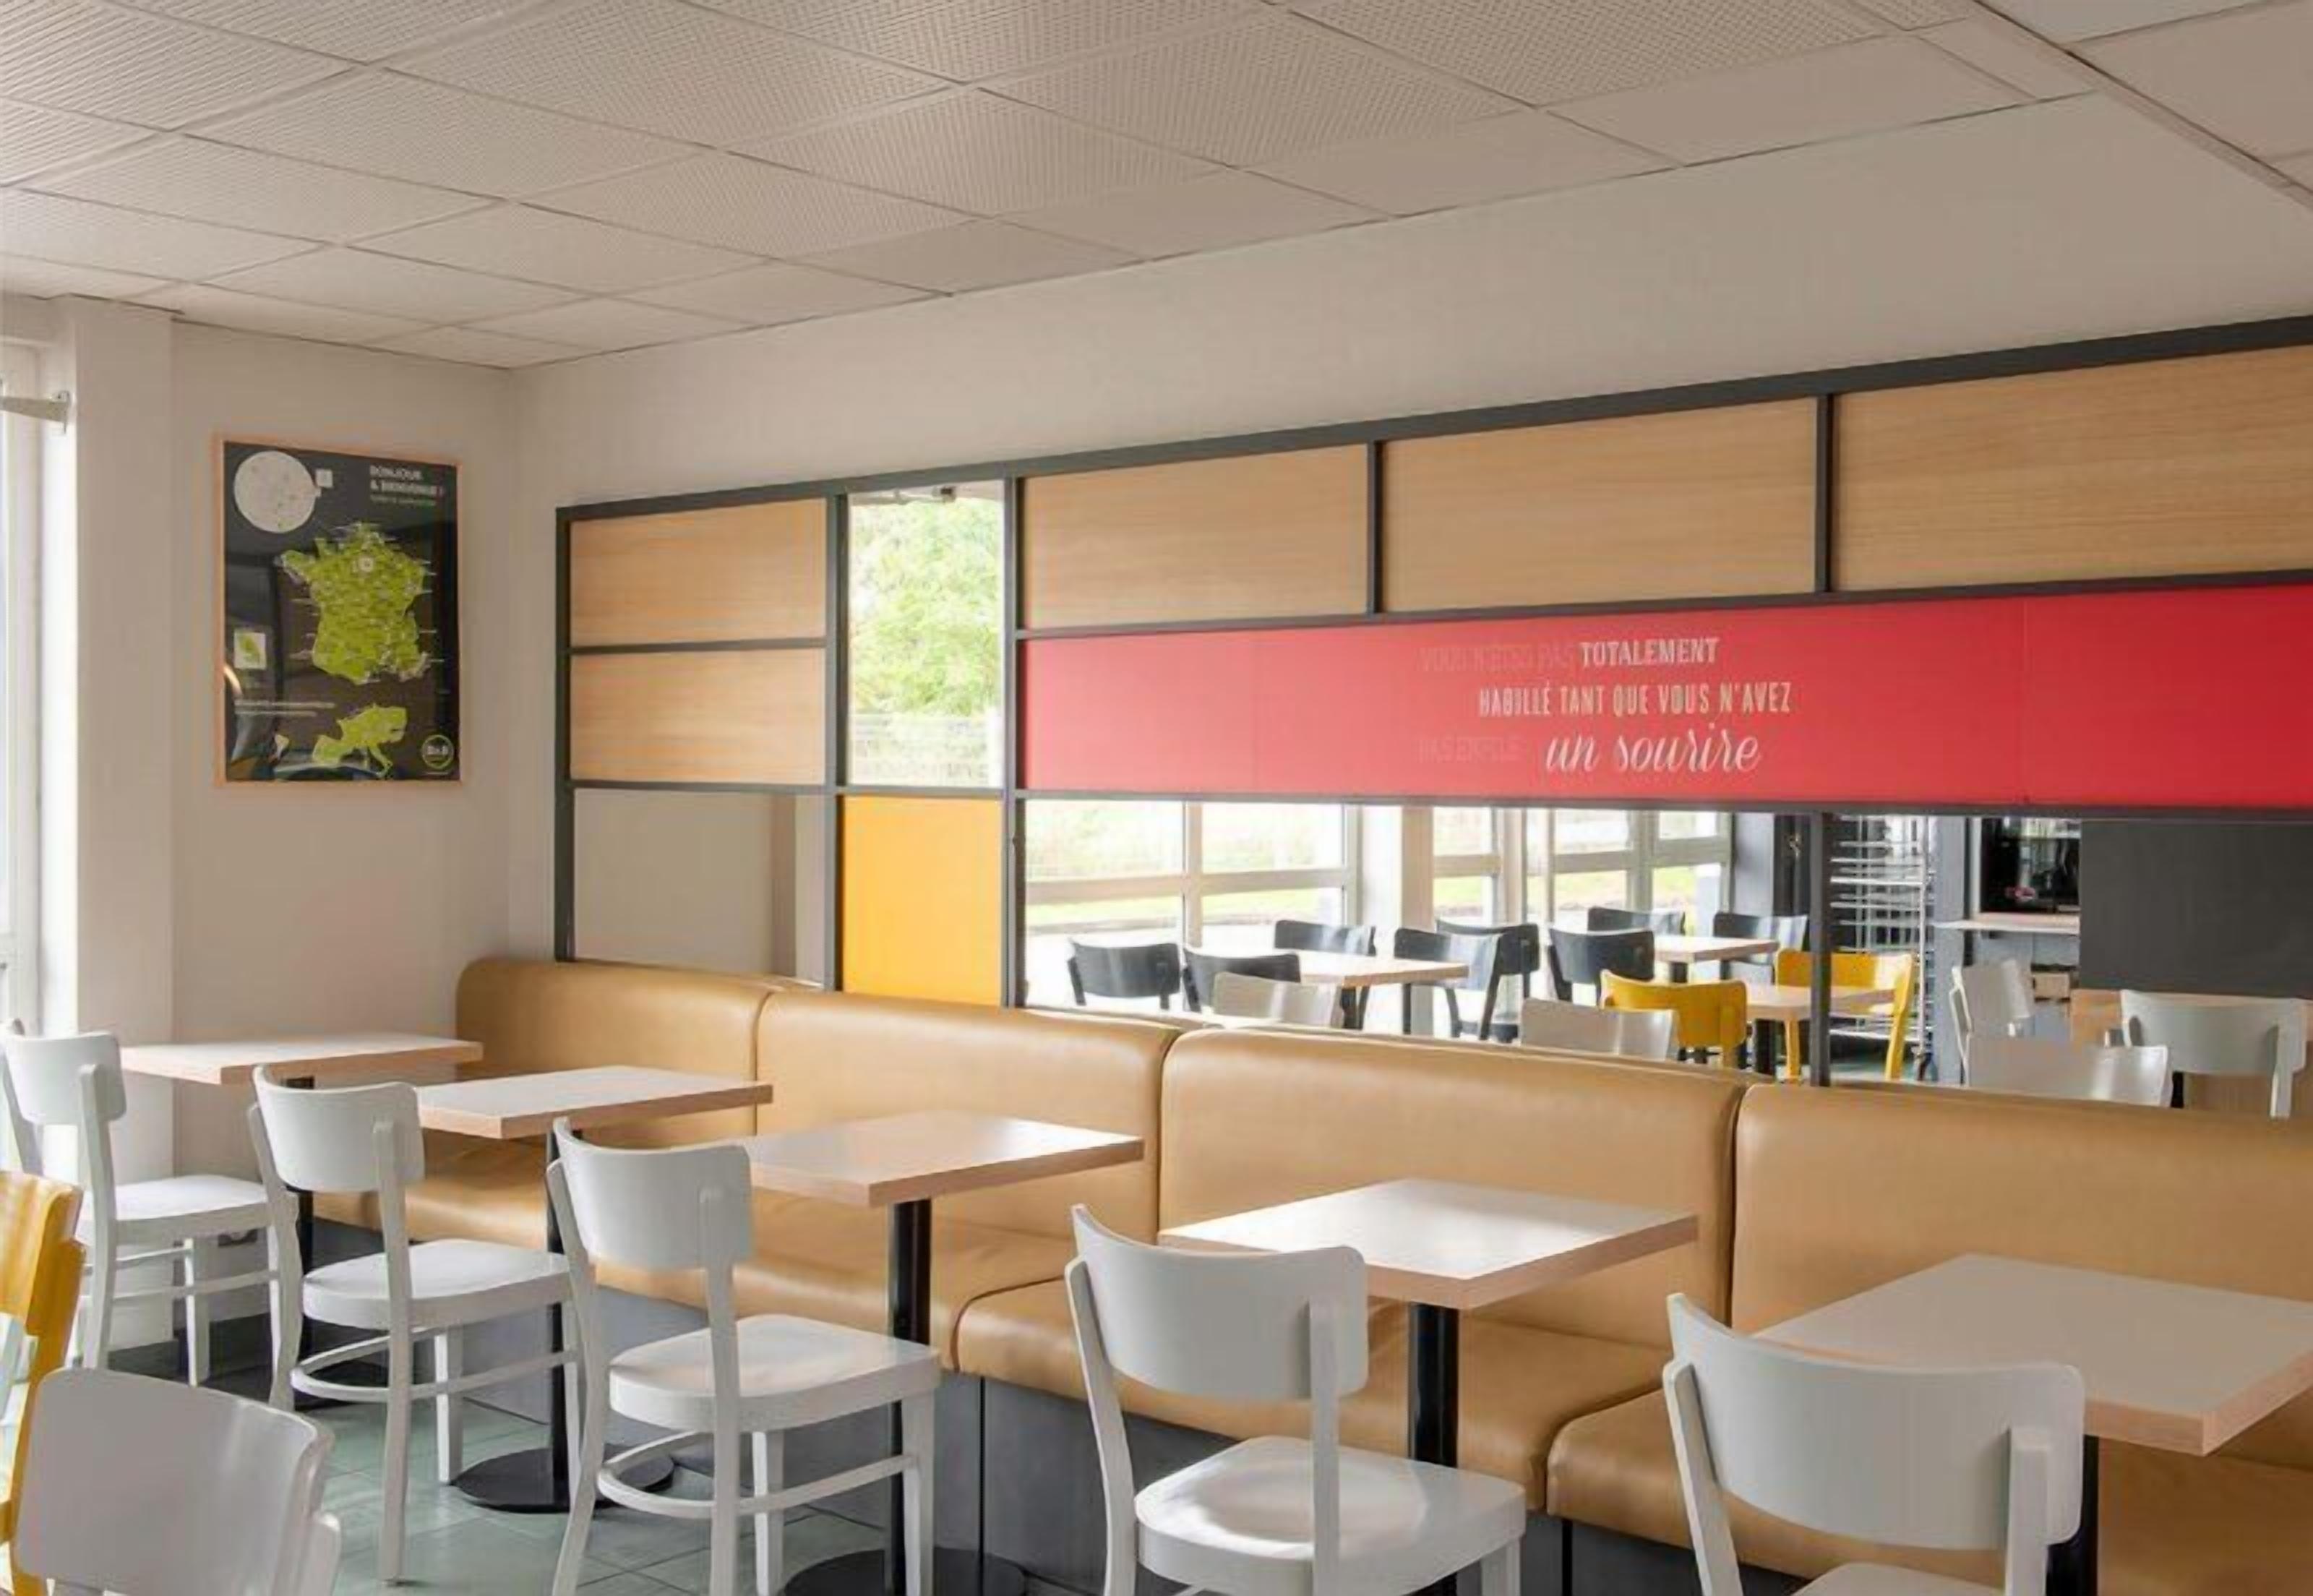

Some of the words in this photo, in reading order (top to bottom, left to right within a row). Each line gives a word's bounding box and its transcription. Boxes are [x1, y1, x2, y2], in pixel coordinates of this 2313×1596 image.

[1579, 638, 1720, 669] TOTALEMENT
[1480, 679, 1550, 717] HABILLÉ
[1561, 685, 1604, 716] TANT
[1613, 685, 1649, 718] QUE
[1658, 683, 1709, 715] VOUS
[1719, 682, 1792, 713] N'AVEZ
[1545, 733, 1600, 773] un
[1614, 722, 1761, 773] sourire
